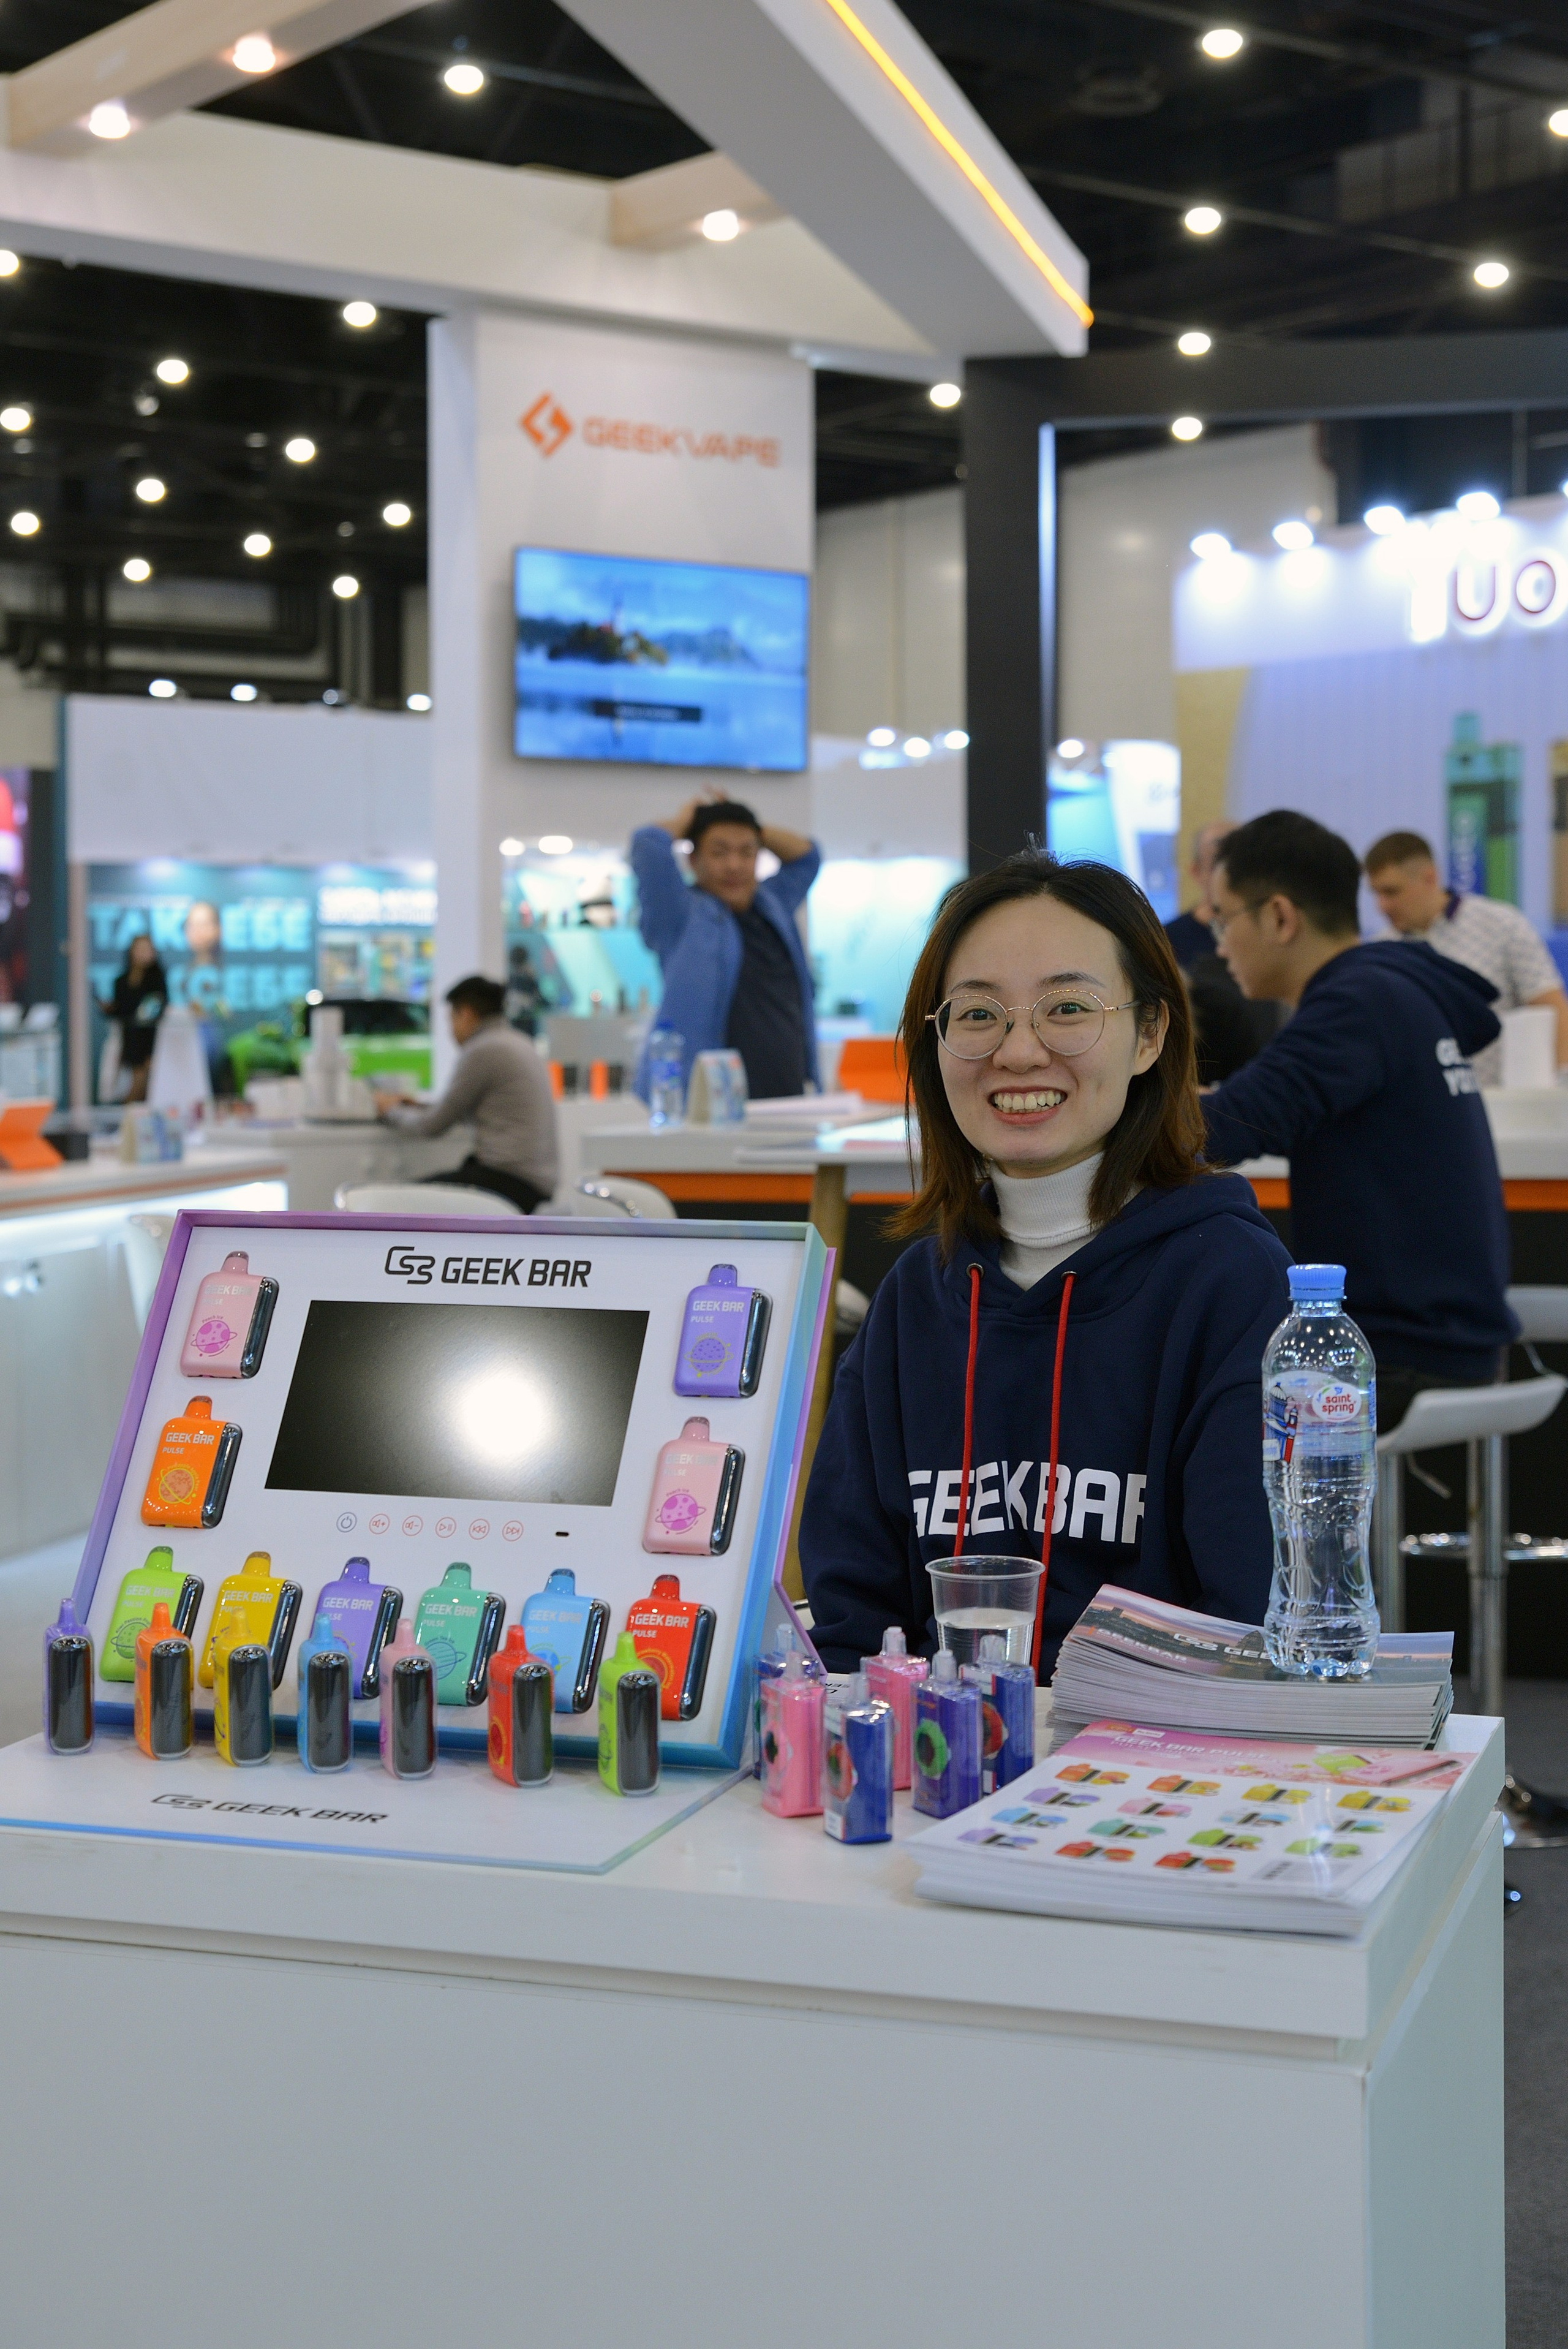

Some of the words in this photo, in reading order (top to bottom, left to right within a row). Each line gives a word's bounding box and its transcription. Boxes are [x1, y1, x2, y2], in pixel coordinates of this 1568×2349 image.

[441, 1257, 525, 1285] GEEK
[527, 1259, 592, 1287] BAR
[693, 1300, 721, 1311] GEEK
[722, 1301, 745, 1312] BAR
[1325, 1394, 1352, 1404] saint
[1322, 1402, 1355, 1415] spring
[165, 1432, 193, 1443] GEEK
[192, 1434, 215, 1445] BAR
[126, 1585, 151, 1596] GEEK
[223, 1591, 251, 1601] GEEK
[251, 1592, 273, 1603] BAR
[323, 1597, 350, 1609] GEEK
[350, 1598, 374, 1611] BAR
[425, 1603, 453, 1616] GEEK
[454, 1605, 477, 1617] BAR
[529, 1609, 556, 1621] GEEK
[635, 1613, 665, 1627] GEEK
[665, 1615, 689, 1628] BAR
[423, 1619, 445, 1627] PULSE
[632, 1629, 657, 1638] PULSE
[1114, 1735, 1166, 1748] GEEK
[1165, 1743, 1205, 1755] BAR
[212, 1801, 313, 1818] GEEK
[309, 1809, 389, 1825] BAR
